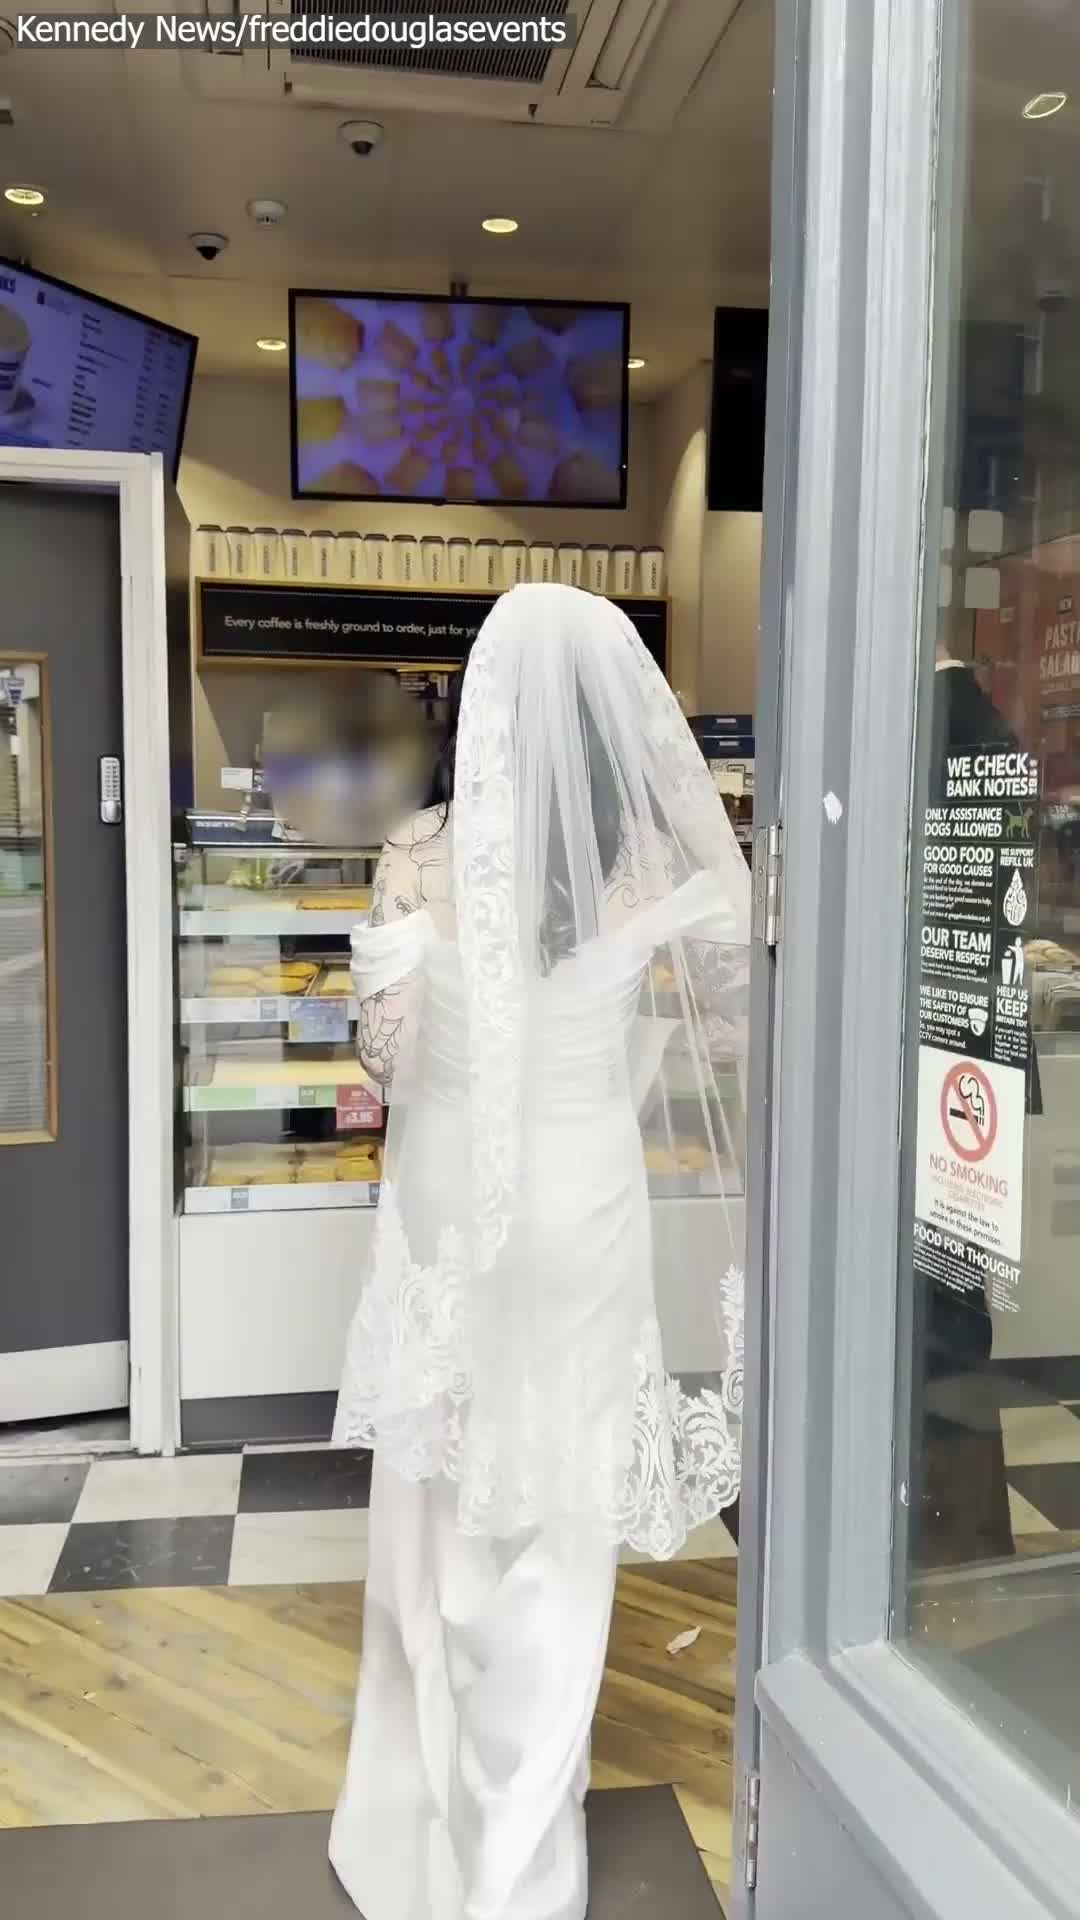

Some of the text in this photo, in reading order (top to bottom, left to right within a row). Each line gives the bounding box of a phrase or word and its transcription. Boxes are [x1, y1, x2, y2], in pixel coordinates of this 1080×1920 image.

[225, 616, 255, 630] Every
[257, 617, 292, 629] coffee
[294, 618, 303, 630] is
[304, 618, 340, 633] freshly
[342, 620, 380, 634] ground
[382, 622, 394, 633] to
[396, 622, 426, 636] order,
[427, 624, 447, 637] just
[449, 624, 463, 635] for
[947, 753, 1029, 778] WE CHECK
[946, 778, 981, 797] BANK
[984, 777, 1028, 796] NOTES
[925, 808, 1002, 821] ONLY ASSISTANCE
[924, 822, 1002, 837] DOGS ALLOWED
[923, 846, 994, 864] GOOD FOOD
[1000, 856, 1034, 867] REFILL UK
[923, 863, 993, 877] FOR GOOD CAUSES
[921, 926, 992, 953] OUR TEAM
[920, 946, 991, 966] DESERVE RESPECT
[919, 985, 989, 1008] WE LIKE TO ENSURE
[997, 985, 1028, 1001] HELP US
[919, 997, 967, 1016] THE SAFETY OF
[996, 997, 1028, 1018] KEEP
[919, 1010, 970, 1028] OUR CUSTOMERS
[919, 1031, 931, 1040] CCTV
[929, 1152, 1009, 1196] NO SMOKING
[946, 1205, 967, 1217] against
[968, 1210, 978, 1222] the
[979, 1216, 990, 1228] law
[991, 1221, 999, 1231] to
[956, 1219, 972, 1232] these
[913, 1223, 942, 1246] FOOD
[944, 1237, 965, 1258] FOR
[966, 1246, 1021, 1285] THOUGHT
